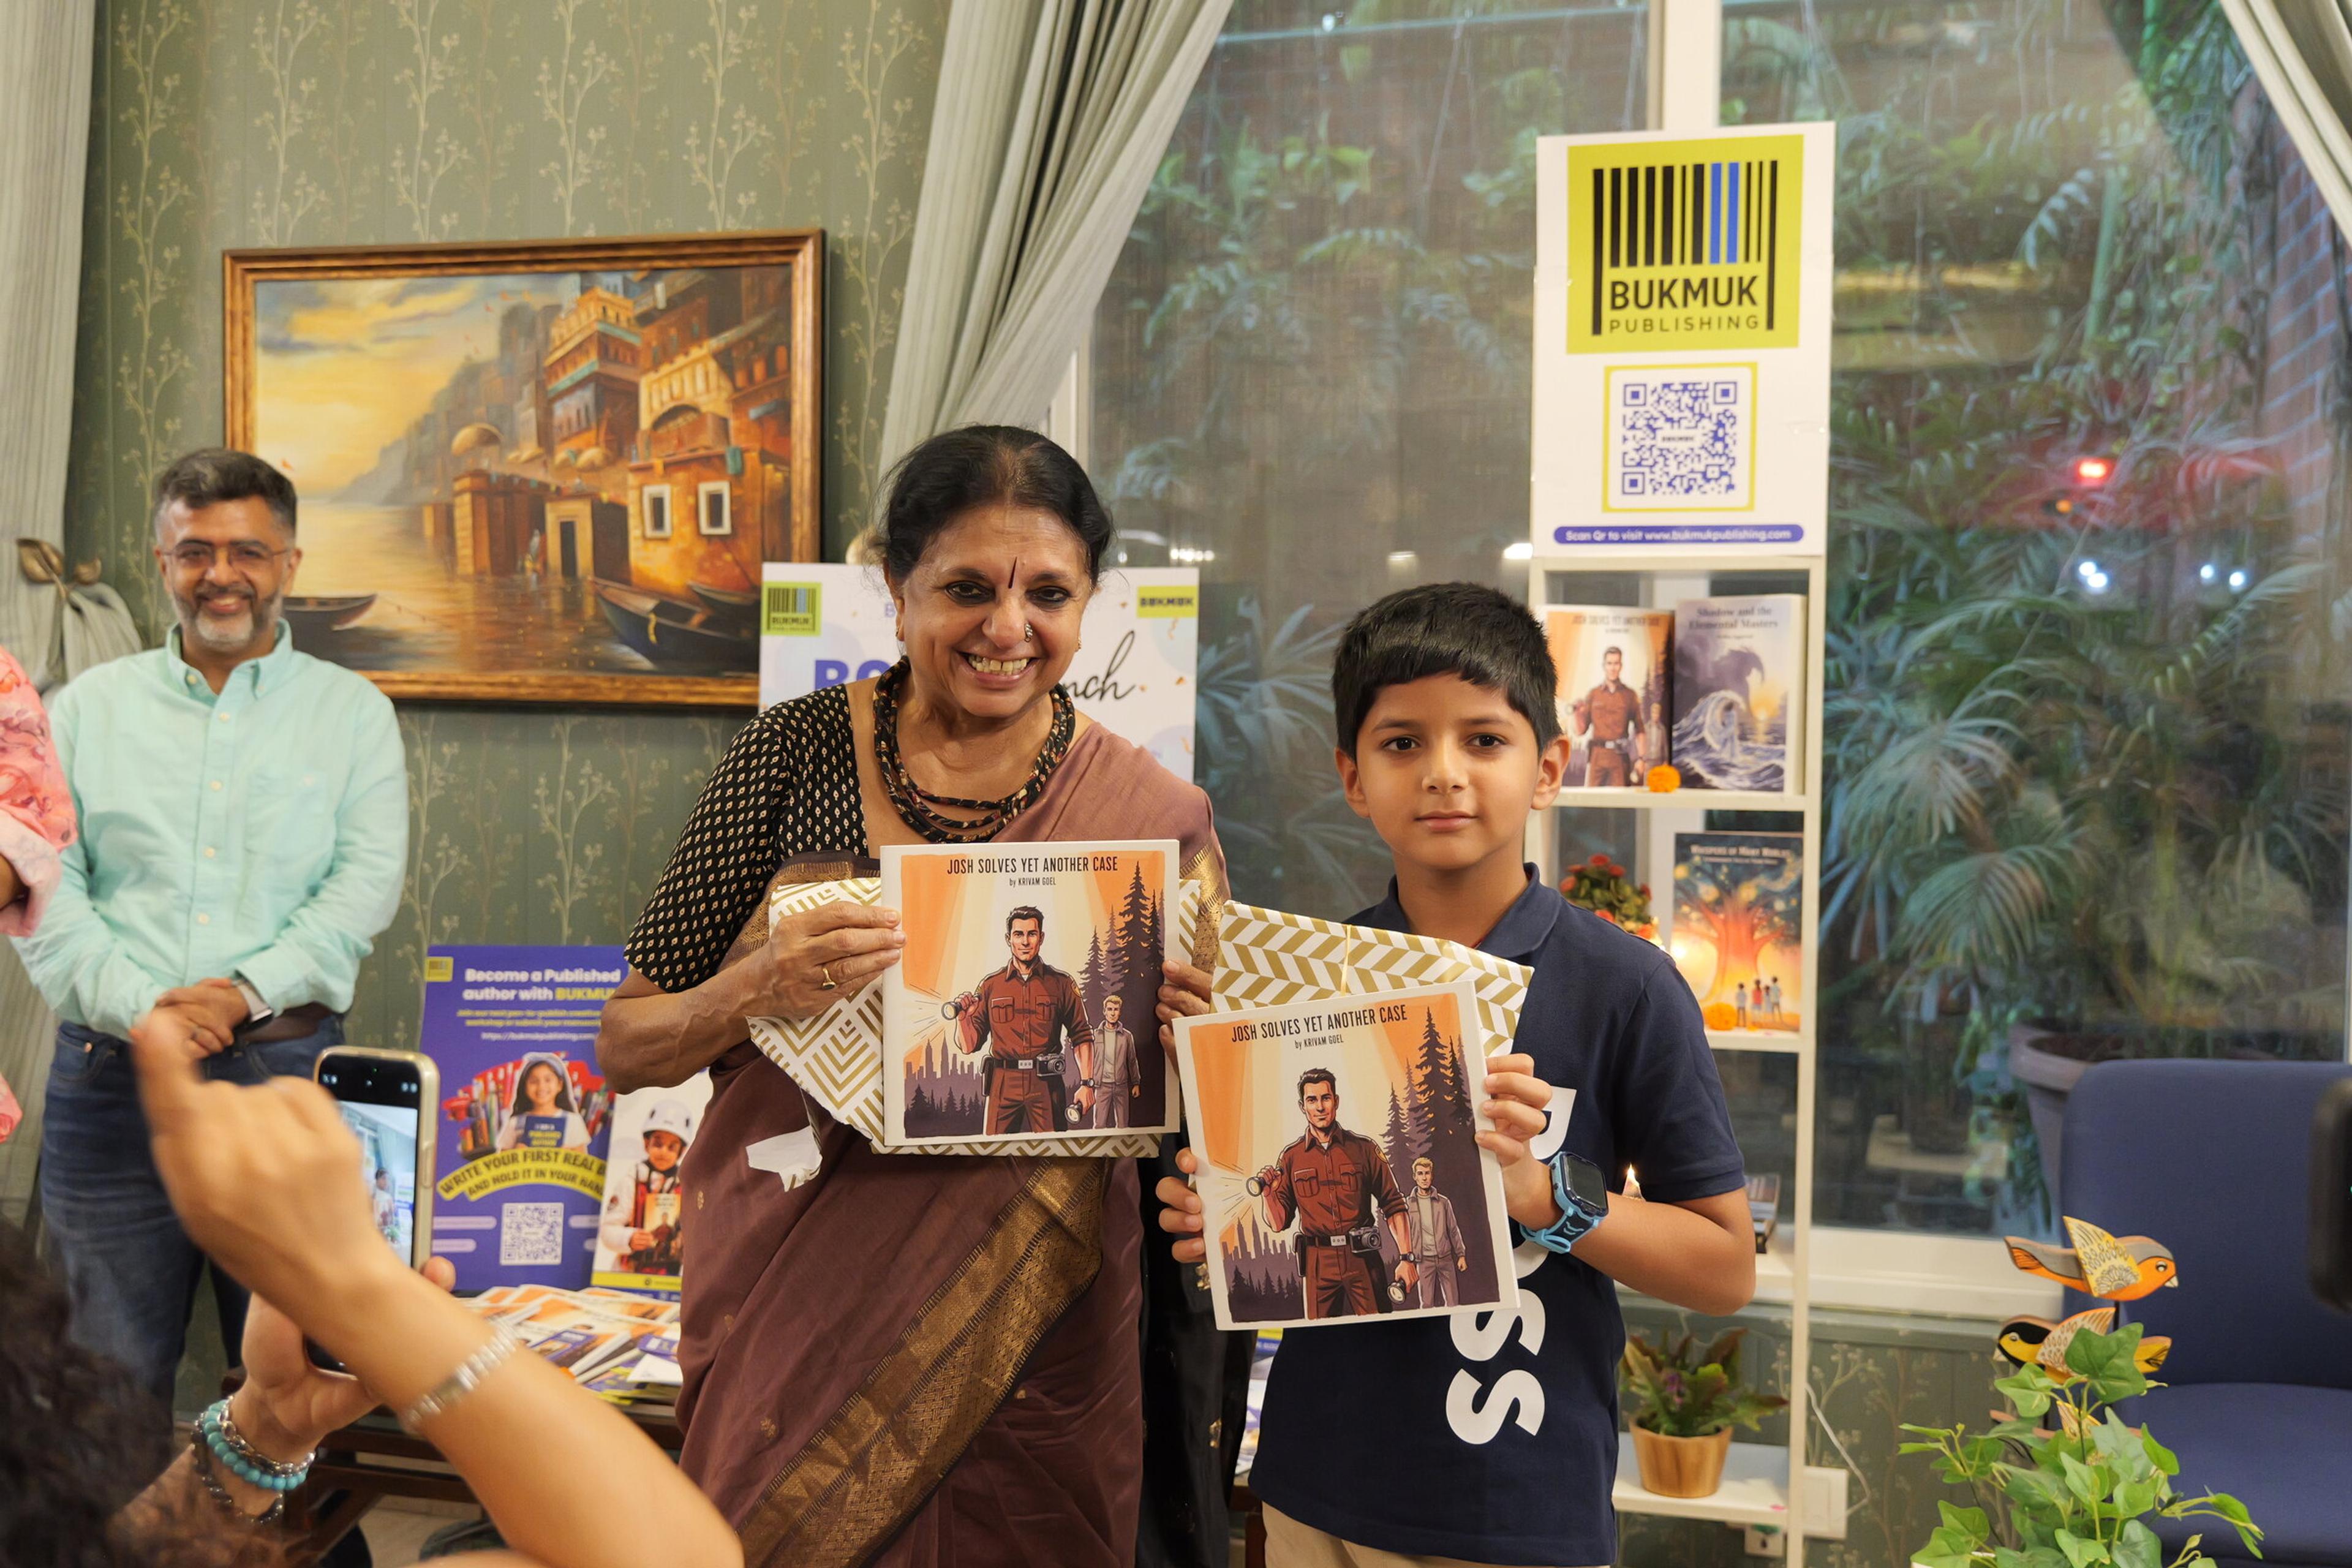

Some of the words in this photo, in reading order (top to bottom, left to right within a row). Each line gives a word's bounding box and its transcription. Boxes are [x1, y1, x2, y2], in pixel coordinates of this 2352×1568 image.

[1610, 276, 1758, 310] BUKMUK
[1609, 315, 1758, 334] PUBLISHING
[1566, 529, 1591, 541] Scan
[1608, 530, 1621, 541] to
[1621, 529, 1643, 541] visit
[948, 859, 973, 874] JOSH
[978, 858, 1016, 873] SOLVES
[1021, 858, 1039, 873] YET
[1042, 858, 1088, 872] ANOTHER
[1093, 857, 1118, 871] CASE
[1009, 878, 1016, 888] by
[1018, 877, 1040, 886] KRIVAM
[1042, 876, 1056, 886] GOEL
[465, 968, 529, 982] Become
[530, 971, 542, 982] a
[545, 968, 621, 982] Published
[462, 987, 518, 1000] author
[519, 986, 553, 1000] with
[1232, 1025, 1257, 1042] JOSH
[1261, 1019, 1301, 1039] SOLVES
[1304, 1016, 1323, 1033] YET
[1328, 1009, 1376, 1030] ANOTHER
[1380, 1005, 1408, 1023] CASE
[1295, 1040, 1302, 1050] by
[1303, 1037, 1327, 1048] KRIVAM
[1329, 1034, 1344, 1044] GOEL
[440, 1165, 482, 1193] WRITE
[483, 1152, 519, 1170] YOUR
[523, 1150, 559, 1163] FIRST
[563, 1152, 595, 1170] REAL
[469, 1178, 490, 1196] AND
[492, 1170, 519, 1185] HOLD
[522, 1169, 530, 1178] IT
[535, 1168, 546, 1178] IN
[551, 1169, 578, 1182] YOUR
[579, 1177, 603, 1196] HAN
